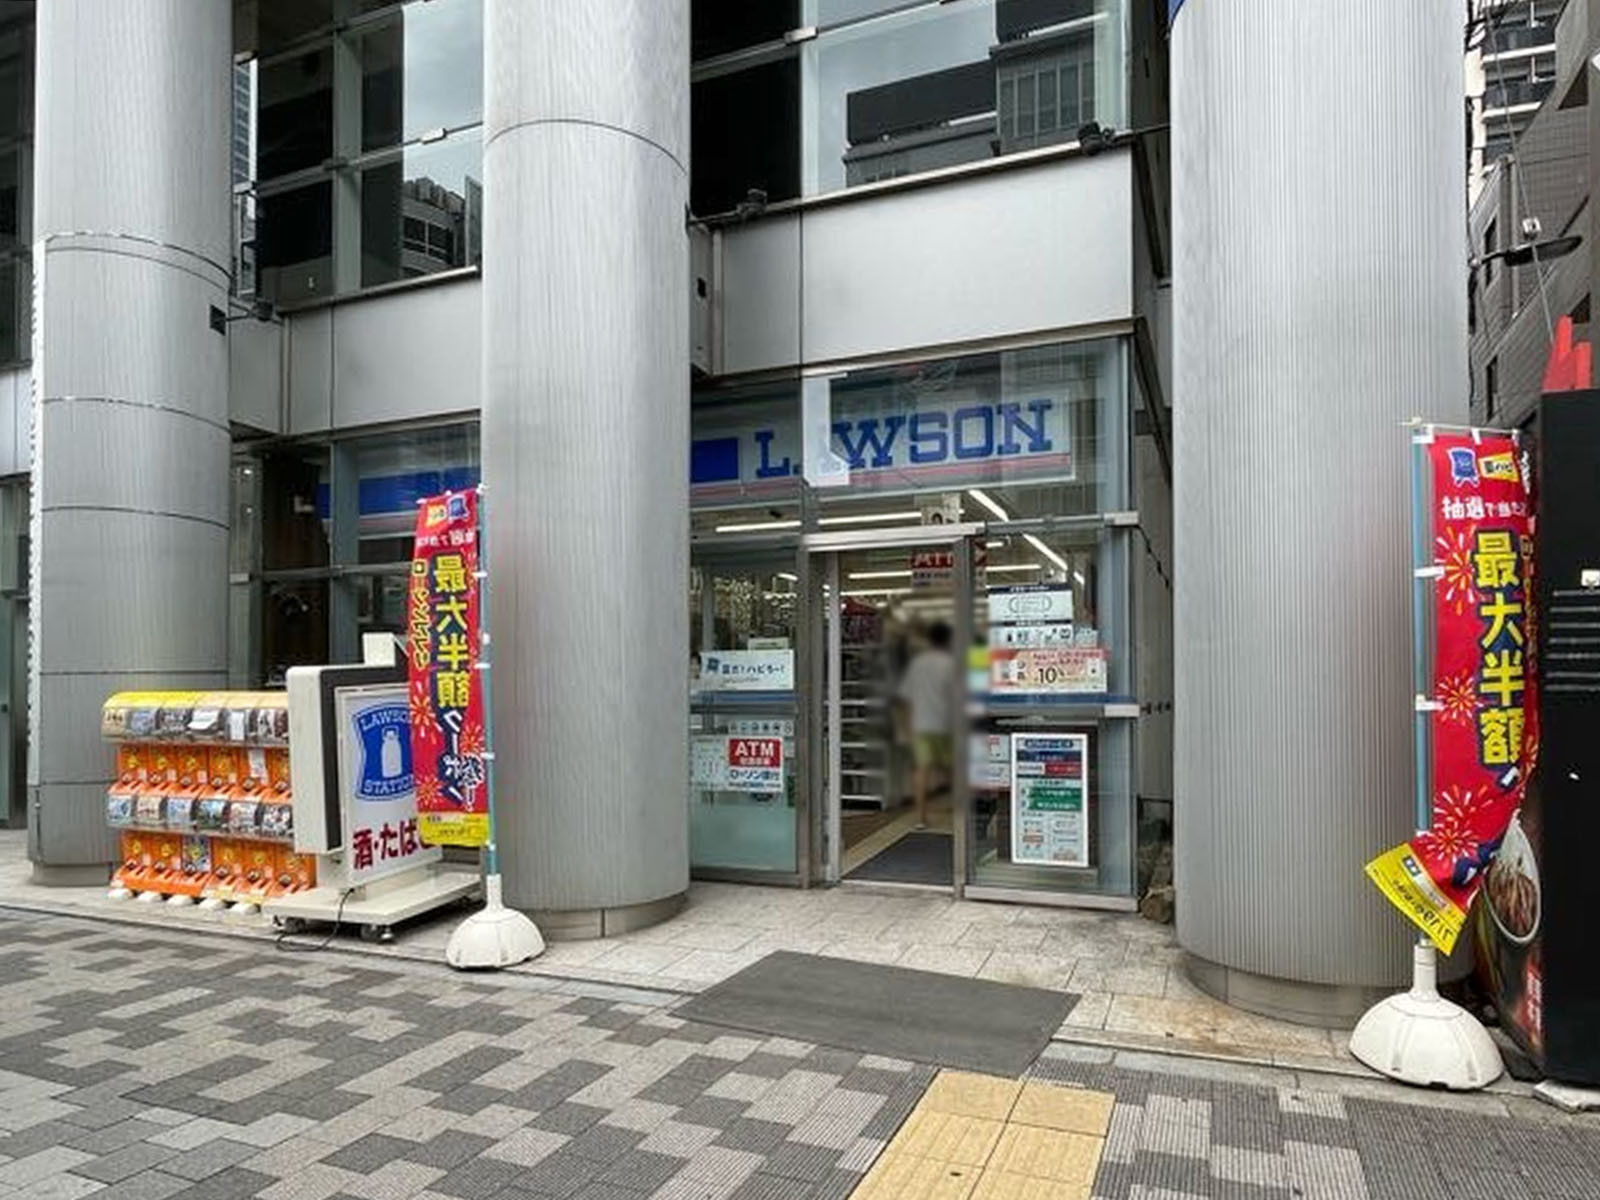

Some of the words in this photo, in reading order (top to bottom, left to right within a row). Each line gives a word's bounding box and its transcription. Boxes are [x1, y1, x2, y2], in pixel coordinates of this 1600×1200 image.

[754, 398, 1053, 478] LWSON
[359, 708, 411, 731] LAWSO
[734, 741, 774, 757] ATM
[363, 772, 414, 793] STATIO
